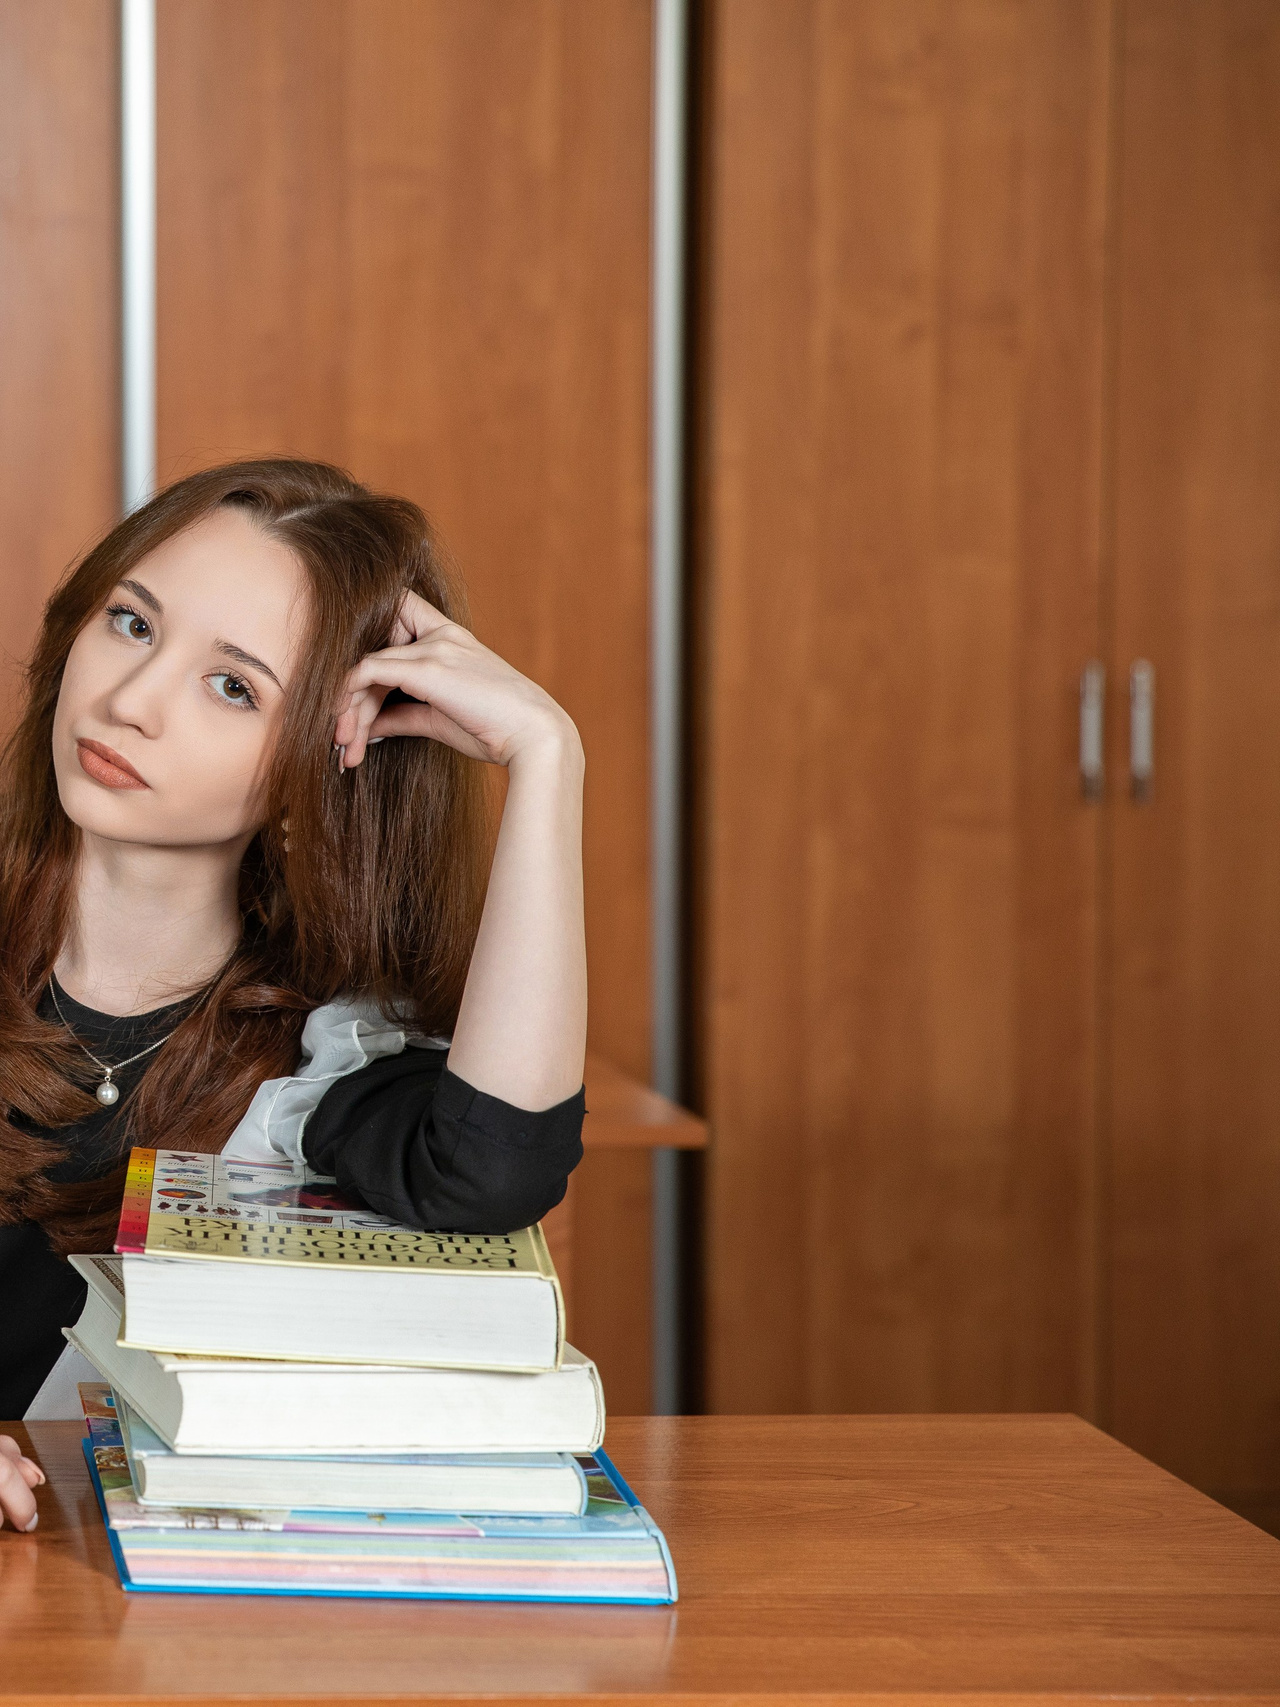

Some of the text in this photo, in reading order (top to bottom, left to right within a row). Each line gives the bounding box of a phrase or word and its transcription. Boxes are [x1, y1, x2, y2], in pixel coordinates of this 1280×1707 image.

[166, 1227, 517, 1255] справочник
[181, 1217, 512, 1245] школьника
[241, 1244, 517, 1269] Большой
